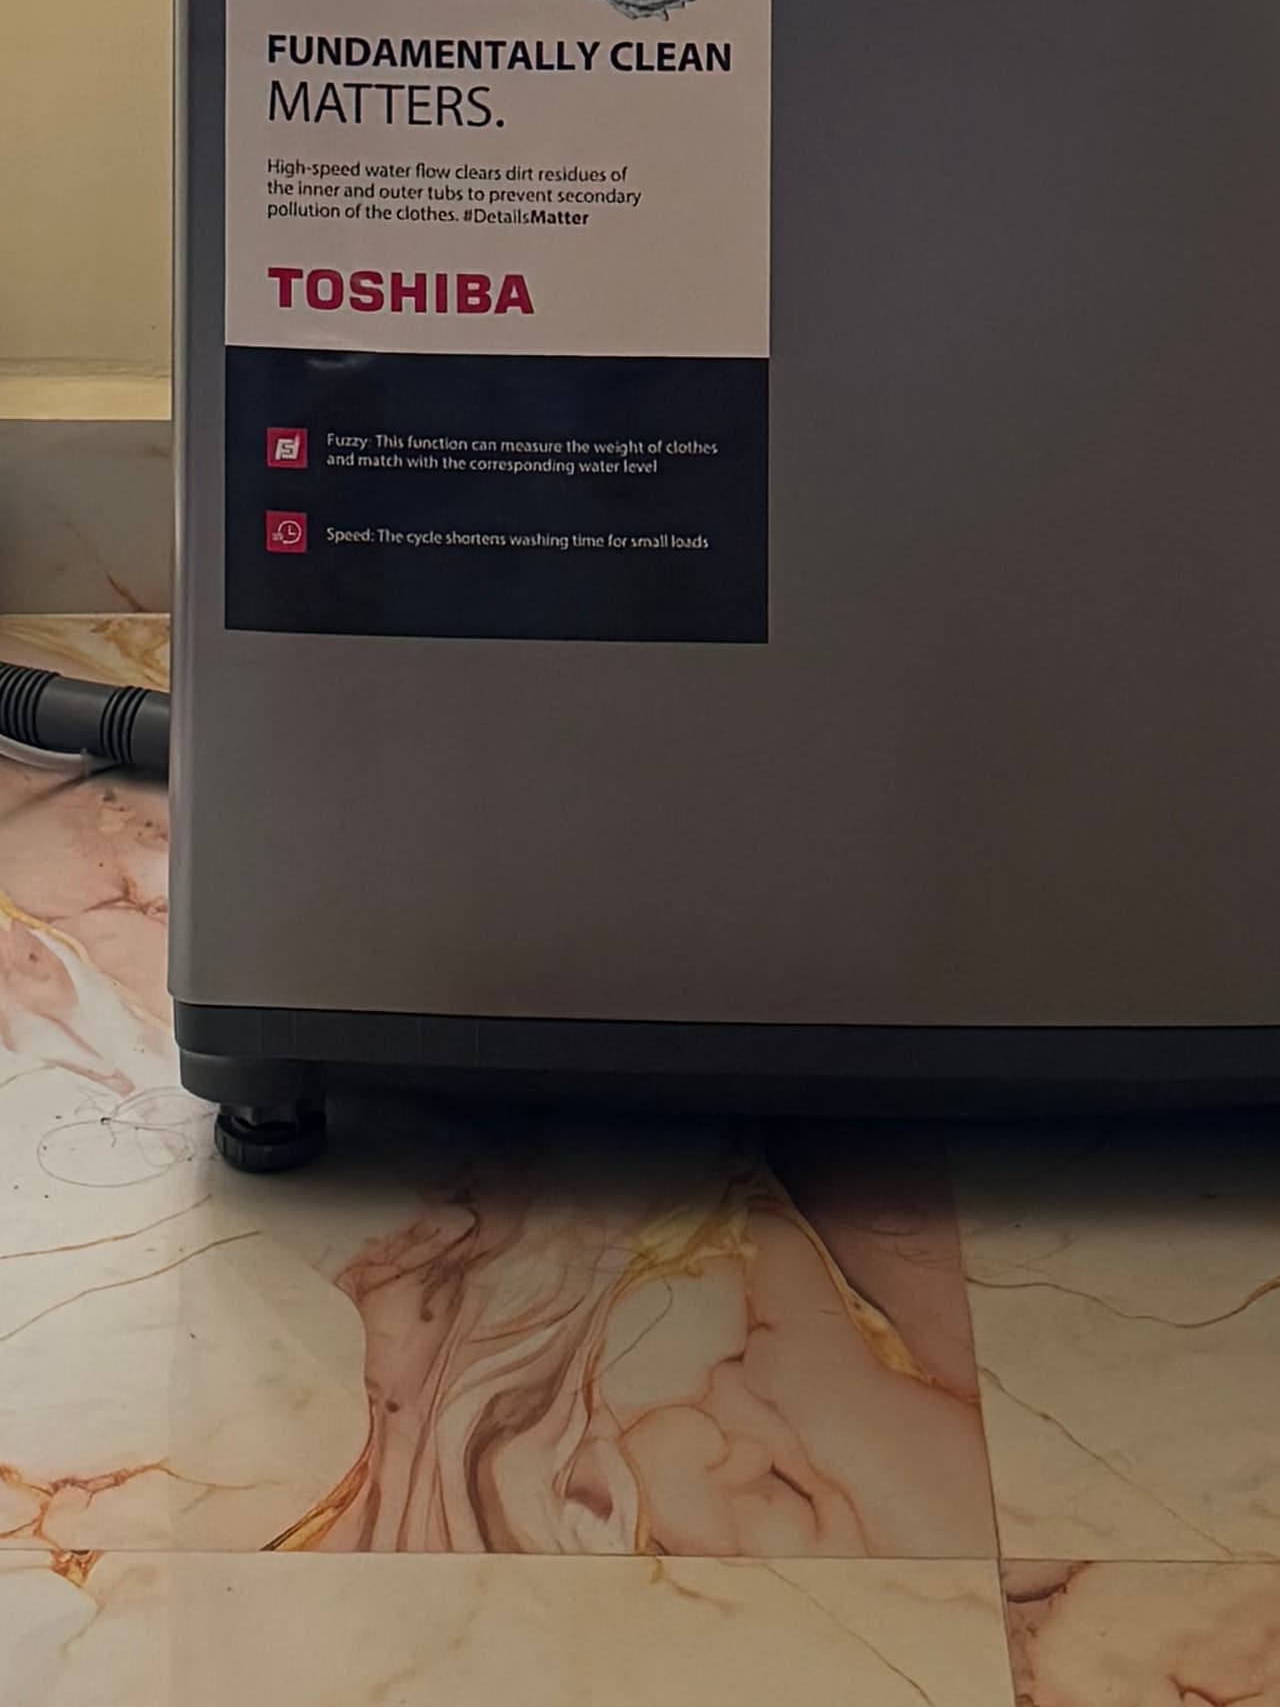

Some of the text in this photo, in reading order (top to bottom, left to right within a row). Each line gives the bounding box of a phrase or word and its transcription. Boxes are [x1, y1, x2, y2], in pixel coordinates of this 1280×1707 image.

[268, 34, 732, 72] FUNDAMENTALLY CLEAN
[269, 80, 505, 128] MATTERS.
[267, 158, 628, 182] High-speed water flow clears dirt residues of
[267, 180, 642, 207] the inner and outer tubs to prevent secondary
[267, 202, 590, 225] pollution of the clothes. #DetailsMatter
[268, 267, 535, 315] TOSHIBA
[375, 433, 405, 449] This
[408, 435, 468, 451] function
[471, 439, 497, 452] can
[500, 440, 562, 454] measure
[566, 439, 590, 454] the
[593, 440, 645, 457] weight
[647, 439, 663, 454] of
[665, 439, 719, 455] clothes
[326, 452, 658, 475] and match with the corresponding water level
[326, 526, 710, 550] Speed: The cycle shortens washing time for small loads
